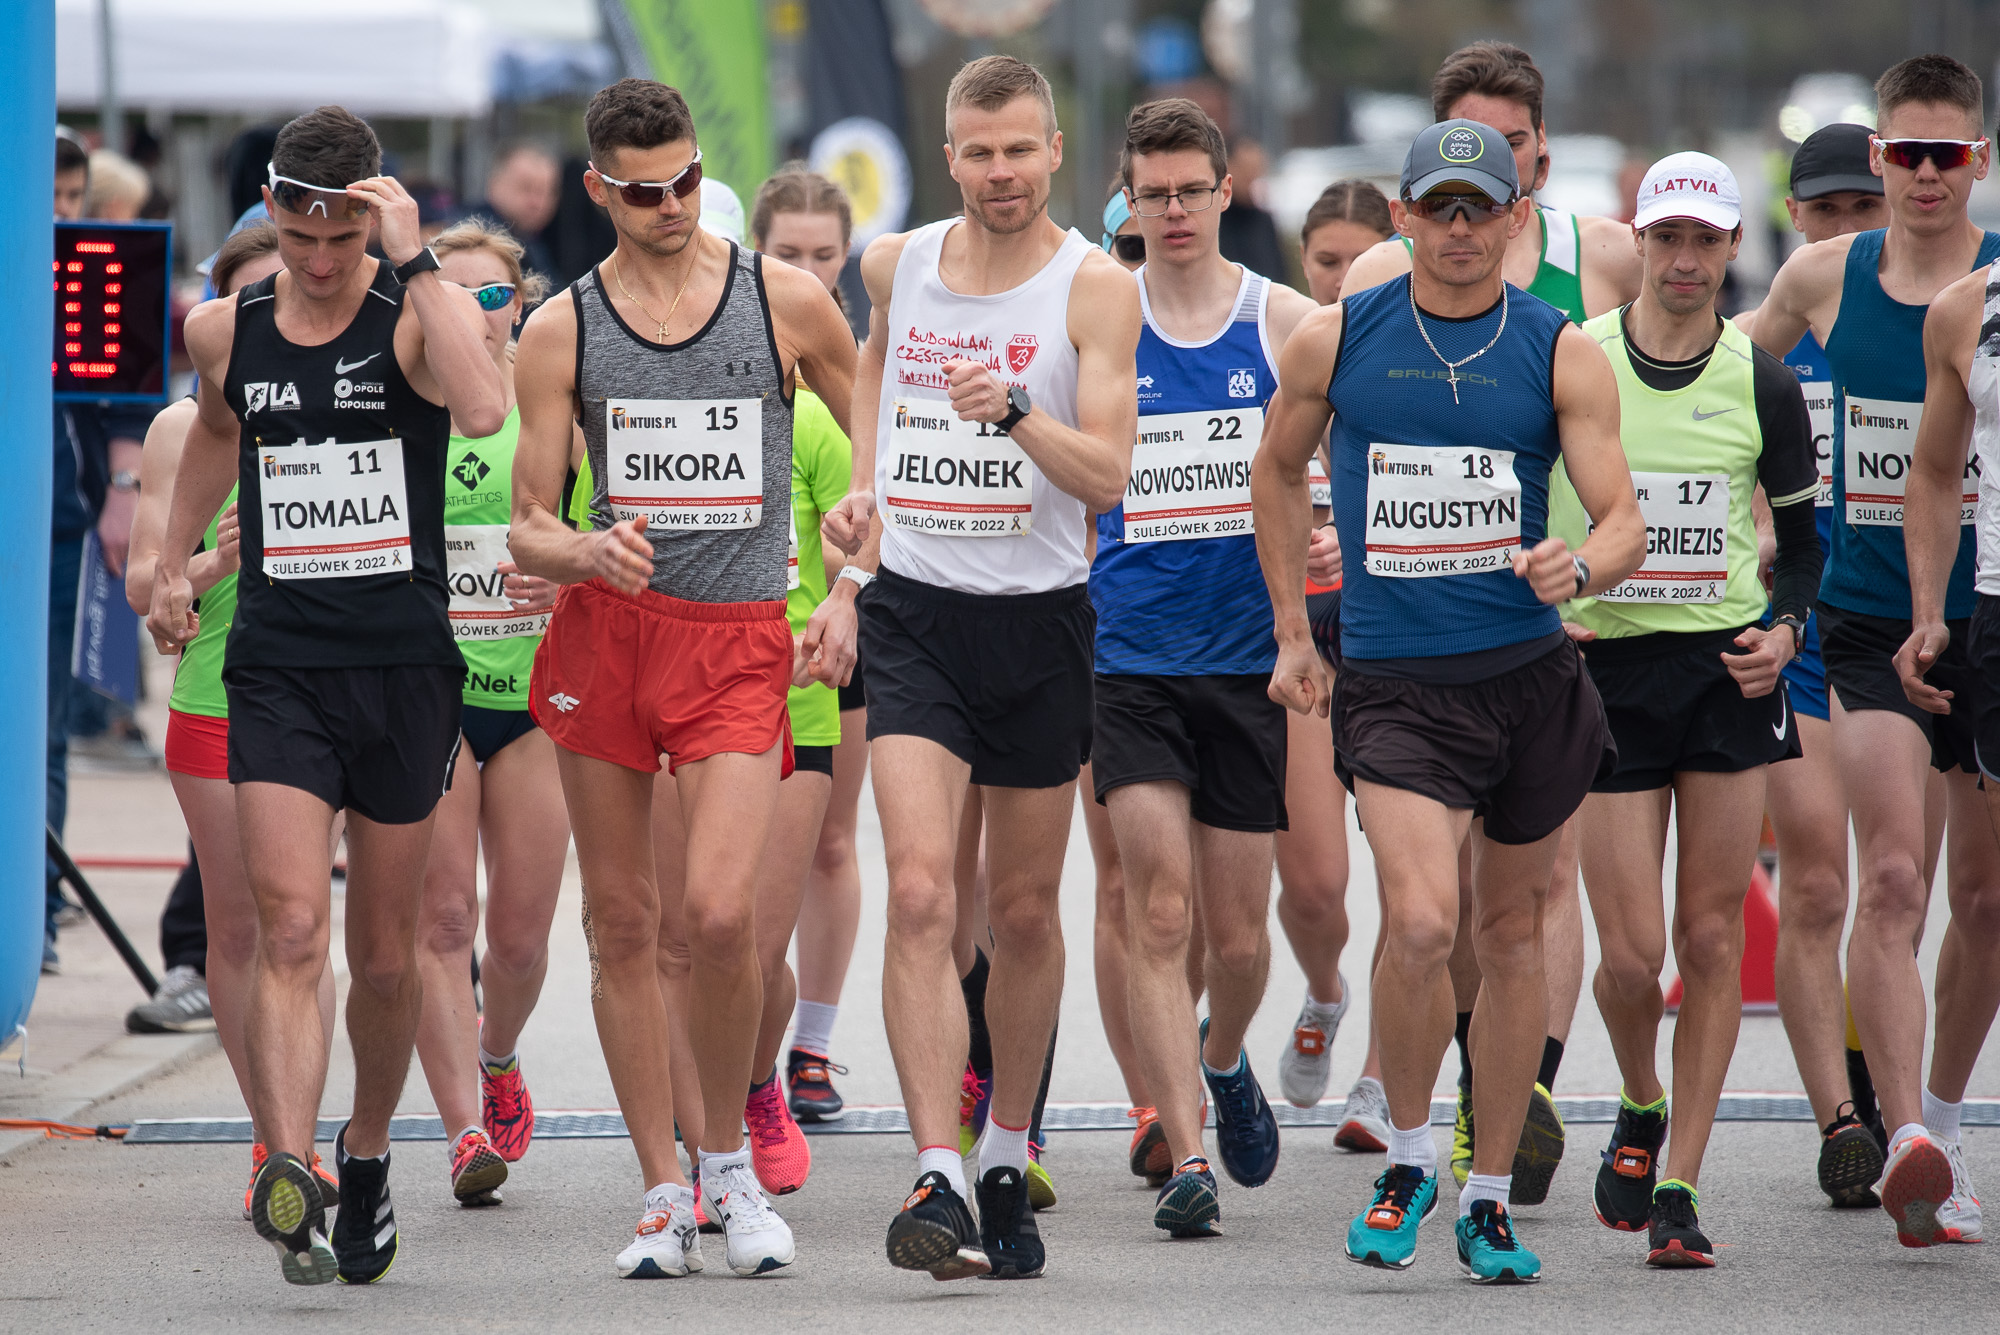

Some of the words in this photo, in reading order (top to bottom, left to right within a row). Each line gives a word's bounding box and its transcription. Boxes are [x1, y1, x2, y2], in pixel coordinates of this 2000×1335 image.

[1448, 148, 1471, 157] 365
[1654, 178, 1719, 196] LATVIA
[1014, 337, 1032, 345] CKS
[1011, 347, 1029, 367] B
[1387, 369, 1498, 387] BRUBECK
[354, 385, 384, 393] OPOLE
[339, 400, 386, 410] OPOLSKIE
[626, 417, 677, 429] INTUIS.PL
[704, 406, 738, 431] 15
[906, 415, 950, 431] INTUIS.PL
[1863, 415, 1909, 431] INTUIS.PL
[1138, 430, 1184, 446] INTUIS.PL
[1207, 416, 1242, 442] 22
[276, 463, 321, 477] INTUIS.PL
[347, 448, 382, 475] 11
[624, 453, 745, 481] SIKORA
[892, 453, 1024, 489] JELONEK
[1385, 462, 1433, 476] INTUIS.PL
[1462, 453, 1494, 479] 18
[1858, 451, 1981, 480] NOK
[445, 491, 503, 507] ATHLETICS
[1678, 480, 1712, 505] 17
[268, 494, 400, 531] TOMALA
[704, 512, 737, 525] 2022
[1372, 496, 1516, 530] AUGUSTYN
[1855, 508, 1904, 521] SULEJÓ
[895, 513, 966, 531] SULEJÓWEK
[971, 519, 1005, 531] 2022
[1133, 522, 1209, 539] SULEJÓWEK
[1214, 519, 1246, 532] 2022
[271, 558, 350, 575] SULEJÓWEK
[354, 556, 386, 570] 2022
[1375, 558, 1458, 573] SULEJÓWEK
[1463, 555, 1496, 570] 2022
[448, 572, 509, 597] KOV
[1599, 583, 1667, 598] LEJÓWEK
[1671, 587, 1701, 599] 2022
[452, 623, 499, 636] JÓWEK
[503, 621, 533, 635] 2022
[719, 1163, 745, 1174] asics
